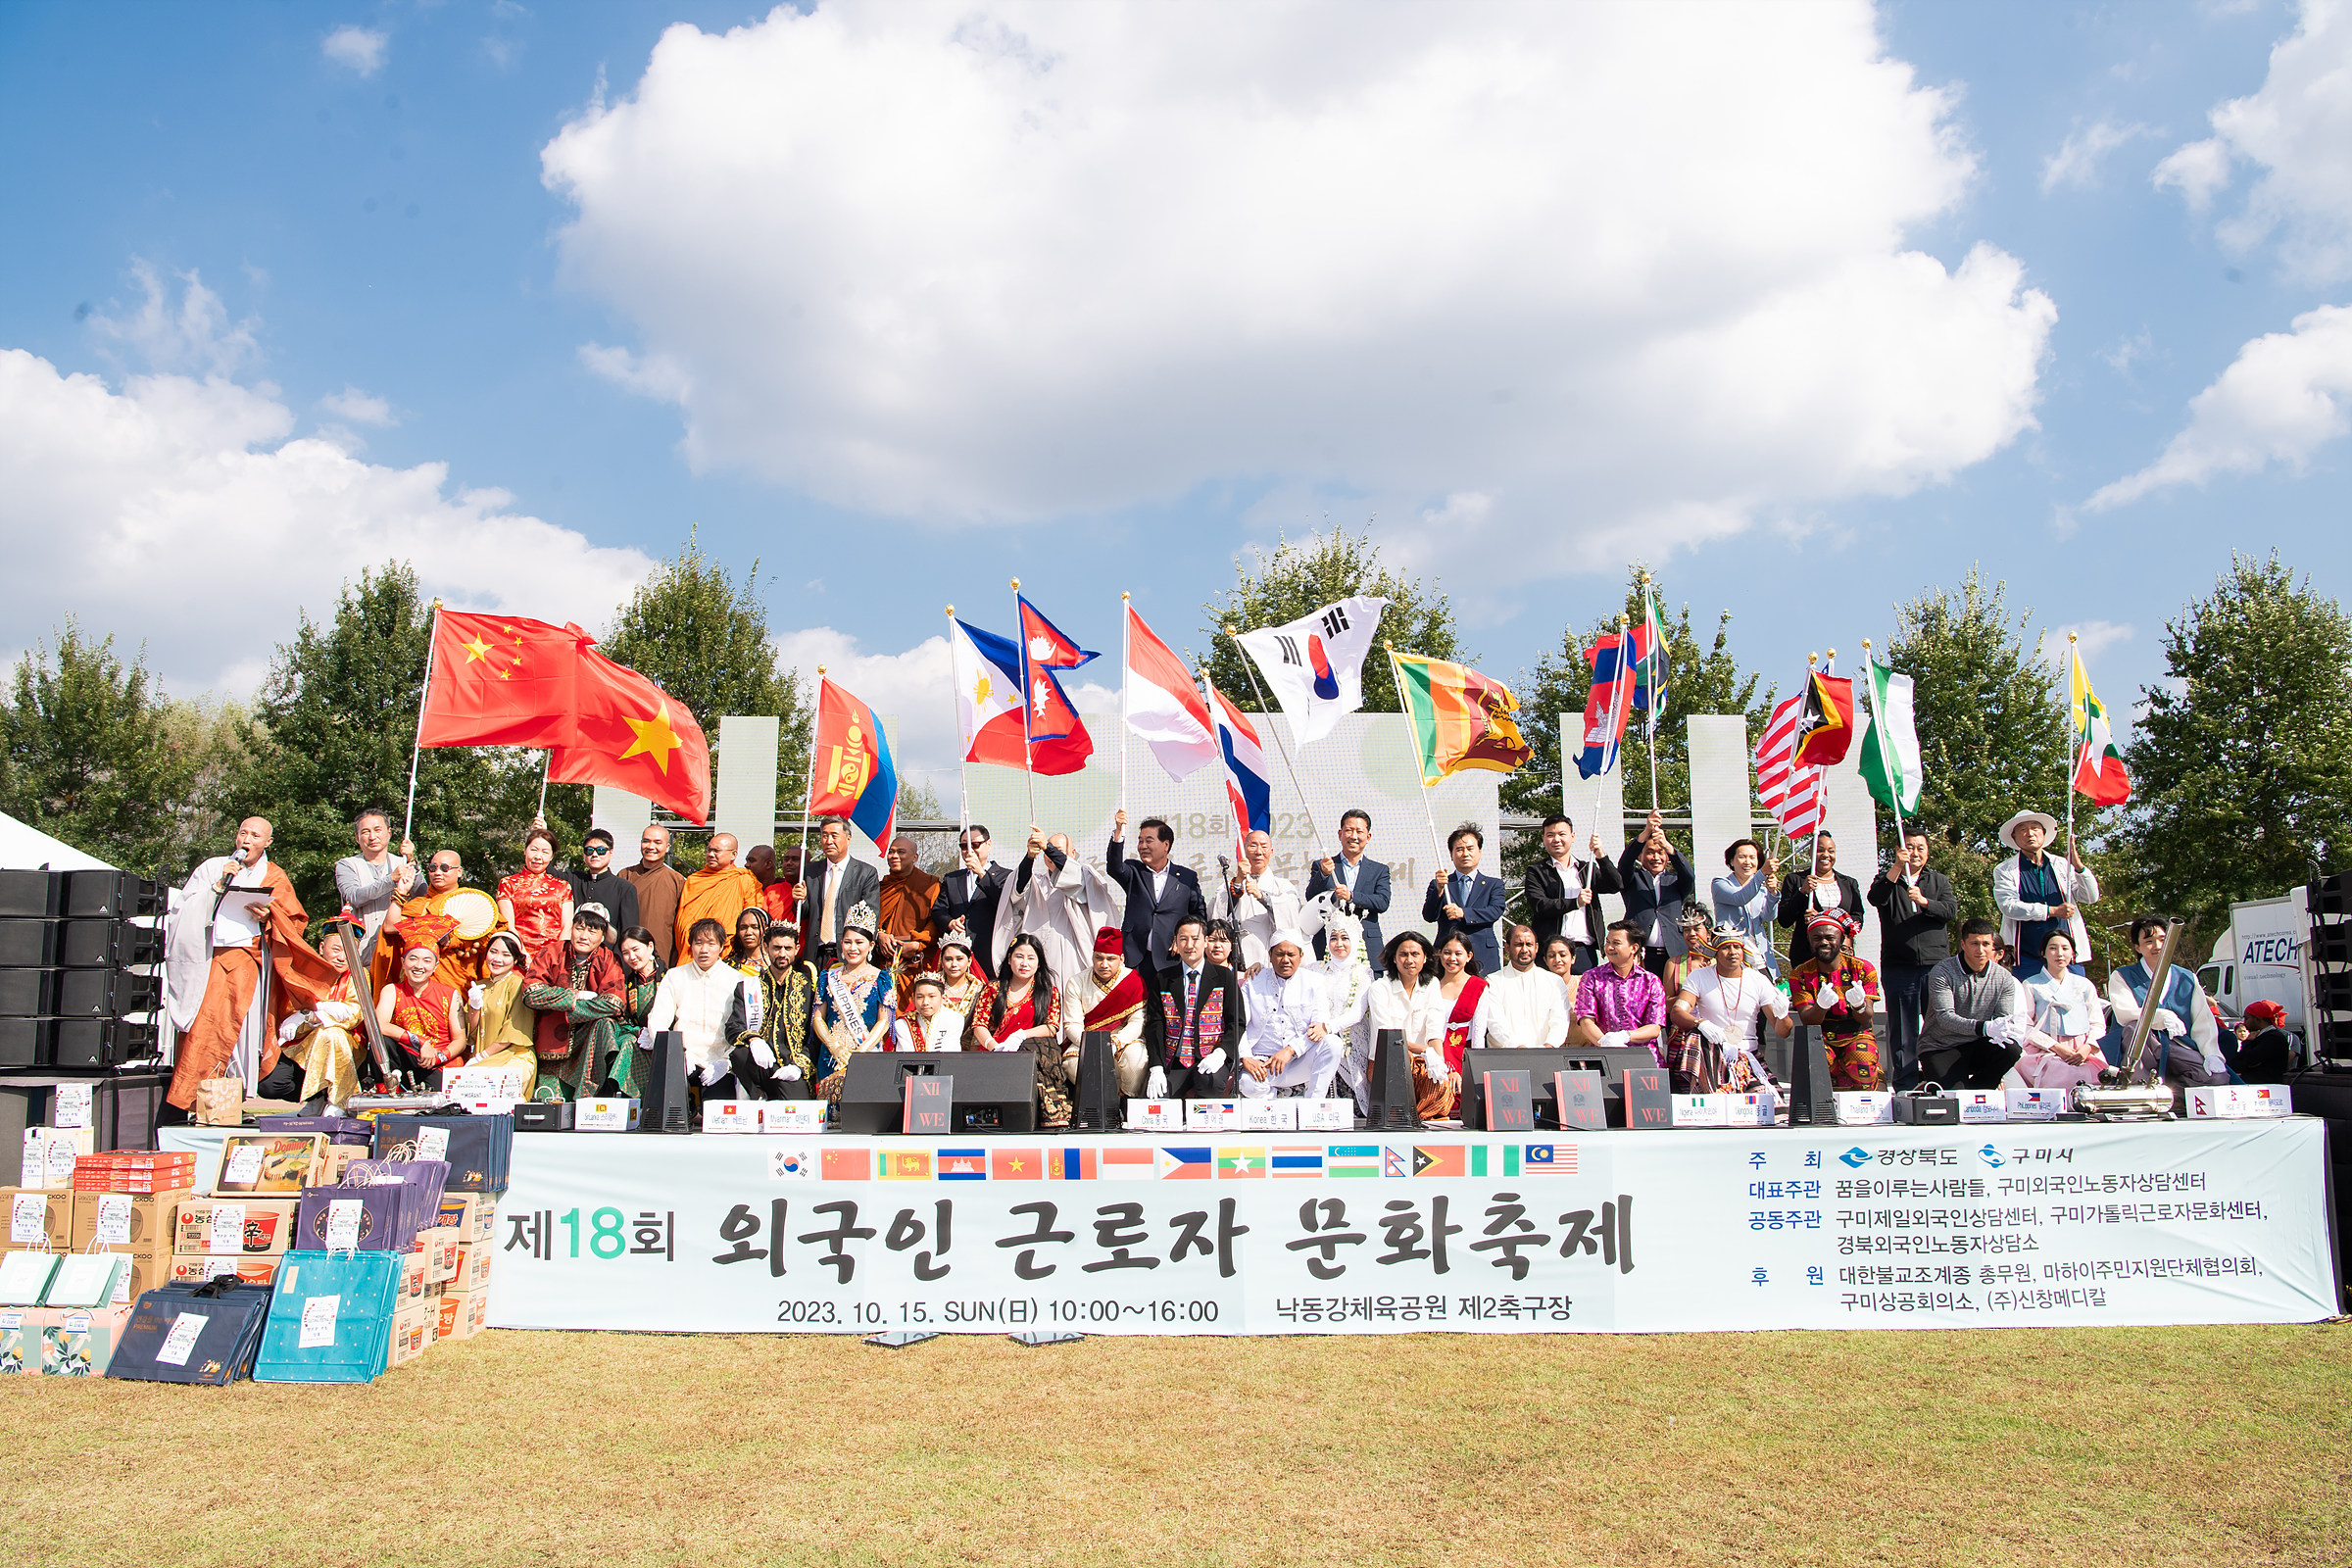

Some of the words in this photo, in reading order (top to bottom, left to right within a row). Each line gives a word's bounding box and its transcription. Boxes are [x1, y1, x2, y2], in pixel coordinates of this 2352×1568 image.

[2242, 938, 2298, 964] ATECH
[830, 974, 863, 1036] PHILIPPINES
[919, 1113, 945, 1127] WE
[1249, 1115, 1267, 1124] Korea
[1502, 1109, 1529, 1124] WE
[1574, 1108, 1601, 1123] WE
[1642, 1108, 1667, 1123] WE
[273, 1140, 307, 1152] Domino
[1878, 1149, 1957, 1166] 경상북도
[2013, 1149, 2073, 1164] 구미시
[1750, 1180, 1821, 1200] 대표주관
[1836, 1179, 1989, 1198] 꿈을이루는사람들,
[1998, 1172, 2205, 1196] 구미외국인노동자상담센터
[438, 1214, 458, 1225] 개장
[1748, 1210, 1822, 1230] 공동주관
[1837, 1207, 2042, 1228] 구미제일외국인상담센터,
[2051, 1200, 2267, 1224] 구미가톨릭근로자문화센터,
[504, 1207, 673, 1261] 제18회
[712, 1199, 952, 1285] 외국인
[995, 1198, 1250, 1280] 근로자
[1286, 1193, 1635, 1281] 문화축제
[1838, 1234, 2038, 1254] 경북외국인노동자상담소
[1839, 1266, 1971, 1285] 대한불교조계종
[1980, 1264, 2035, 1285] 총무원,
[2044, 1257, 2262, 1281] 마하이주민지원단체협의회,
[778, 1300, 841, 1324] 2023.
[854, 1302, 887, 1324] 10.
[901, 1302, 933, 1323] 15.
[945, 1298, 1037, 1324] SUN(日)
[1277, 1296, 1446, 1322] 낙동강체육공원
[1458, 1296, 1572, 1320] 제2축구장
[1840, 1293, 1979, 1312] 구미상공회의소,
[1988, 1288, 2106, 1311] (주)신창메디칼
